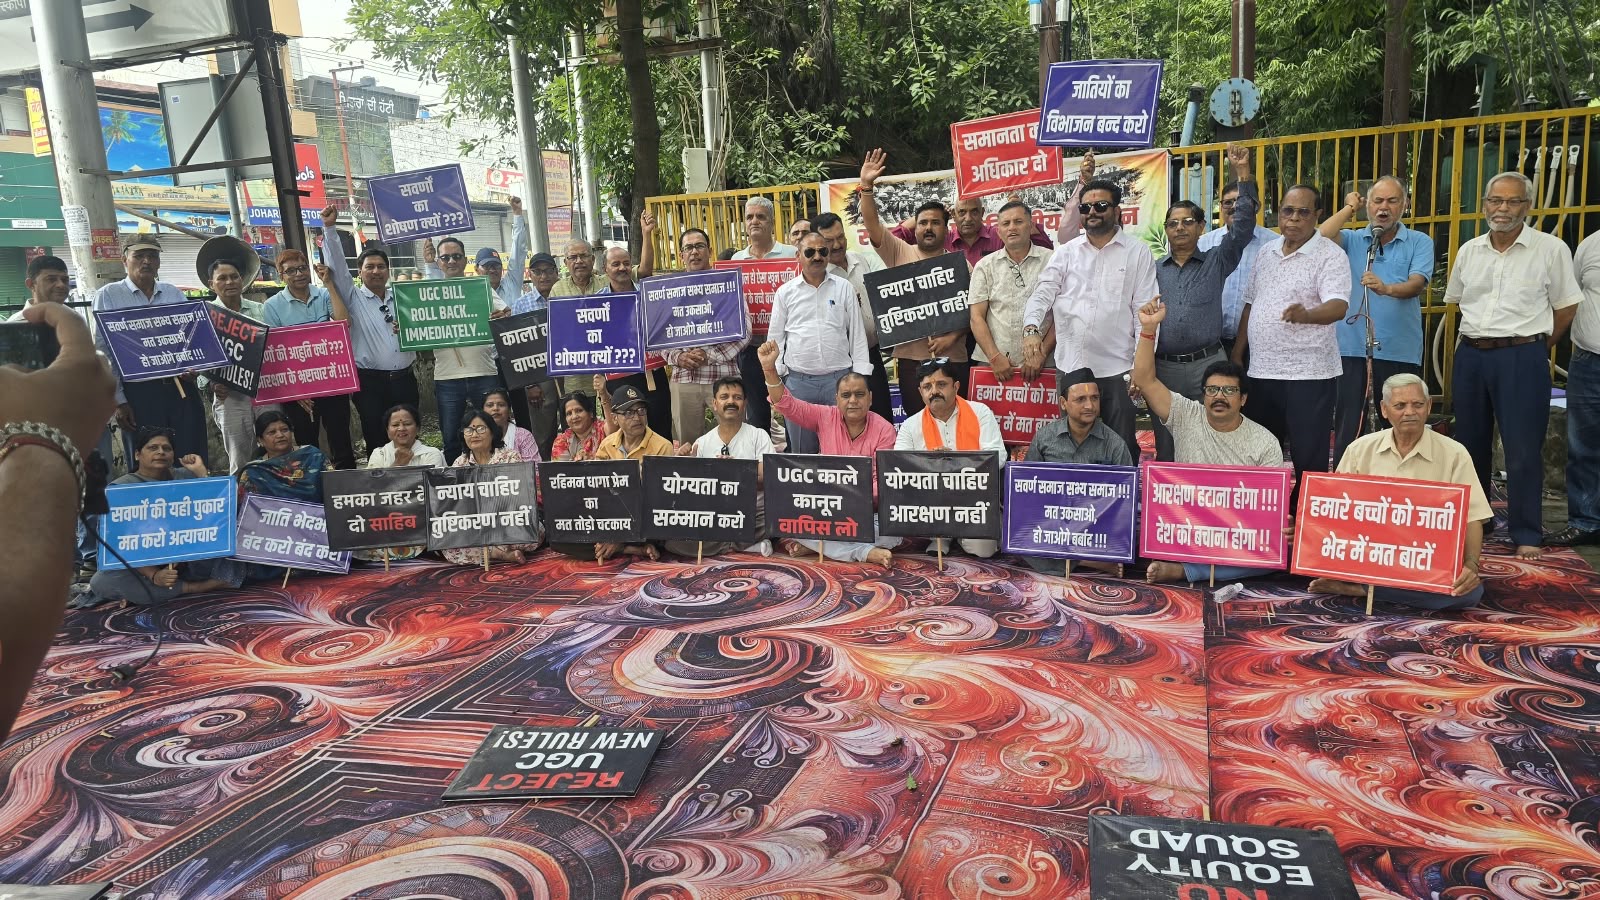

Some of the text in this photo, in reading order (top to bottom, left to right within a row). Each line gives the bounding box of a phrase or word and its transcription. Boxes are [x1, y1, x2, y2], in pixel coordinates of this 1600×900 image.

[1072, 75, 1132, 100] जातियों का
[367, 97, 376, 112] ਦੀ
[378, 98, 394, 114] ਹੱਟੀ
[1046, 110, 1149, 134] विभाजन बन्द करो
[962, 124, 1026, 150] समानता
[972, 150, 1048, 183] अधिकार दो
[398, 176, 434, 196] सवर्णों
[250, 208, 280, 218] JOHAR
[412, 200, 430, 212] का
[385, 212, 464, 236] शोषण क्यों ???
[419, 285, 466, 302] UGC BILL
[648, 280, 736, 302] सवर्ण समाज सभ्य समाज !!!
[877, 266, 955, 298] न्याय चाहिए
[410, 304, 478, 322] ROLL BACK...
[576, 301, 611, 324] सवर्णों
[672, 300, 714, 318] मत उकसाओ,
[877, 290, 970, 334] तुष्टिकरण नहीं
[108, 310, 206, 332] सवर्ण समाज सभ्य समाज !!!
[210, 309, 260, 344] REJECT
[406, 322, 488, 342] IMMEDIATELY...
[666, 320, 724, 338] हो जाओगे बर्बाद !!!
[142, 335, 157, 348] मत
[500, 325, 539, 346] काला
[586, 328, 602, 344] का
[140, 353, 150, 368] हो
[150, 350, 176, 366] जाओगे
[176, 347, 194, 364] बर्बाद
[222, 336, 244, 362] GC
[276, 338, 344, 362] की आहुति क्यों ???
[555, 347, 590, 366] शोषण
[591, 346, 614, 364] क्यों
[615, 348, 636, 364] ???
[288, 368, 297, 385] के
[298, 366, 328, 384] भ्रष्टाचार
[328, 362, 338, 378] में
[338, 364, 350, 378] !!!
[976, 382, 1046, 404] हमारे बच्चों को
[1003, 410, 1017, 432] में
[1016, 416, 1034, 433] मत
[549, 472, 629, 490] रहिमन धागा प्रेम
[662, 472, 740, 496] योग्यता का
[777, 464, 858, 486] UGC काले
[884, 466, 990, 491] योग्यता चाहिए
[332, 488, 412, 510] हमका जहर
[436, 476, 520, 502] न्याय चाहिए
[1014, 476, 1130, 500] सवर्ण समाज सभ्य समाज !!!
[1152, 480, 1278, 512] आरक्षण हटाना होगा !!!
[111, 496, 225, 523] सवर्णों की यही पुकार
[584, 496, 598, 510] का
[792, 493, 842, 518] कानून
[890, 500, 991, 525] आरक्षण नहीं
[1310, 492, 1456, 531] हमारे बच्चों को जाती
[259, 507, 293, 528] जाति
[348, 512, 417, 533] दो साहिब
[430, 504, 533, 538] तुष्टिकरण नहीं
[555, 514, 632, 534] मत तोड़ो चटकाय
[652, 508, 746, 530] सम्मान करो
[778, 514, 858, 538] वापिस लो
[1044, 504, 1098, 526] मत उकसाओ,
[118, 526, 219, 551] मत करो अत्याचार
[242, 532, 316, 558] बंद करो बंद
[1033, 526, 1108, 549] हो जाओगे बर्बाद !!!
[1156, 516, 1271, 552] देश को बचाना होगा !!
[1322, 531, 1436, 571] भेद में मत बांटों
[493, 730, 654, 750] NEW RULES!
[515, 752, 605, 770] UGC
[466, 772, 626, 791] REJECT
[1129, 828, 1301, 860] SQUAD
[1126, 854, 1314, 886] EQUITY
[1177, 882, 1269, 900] NO
